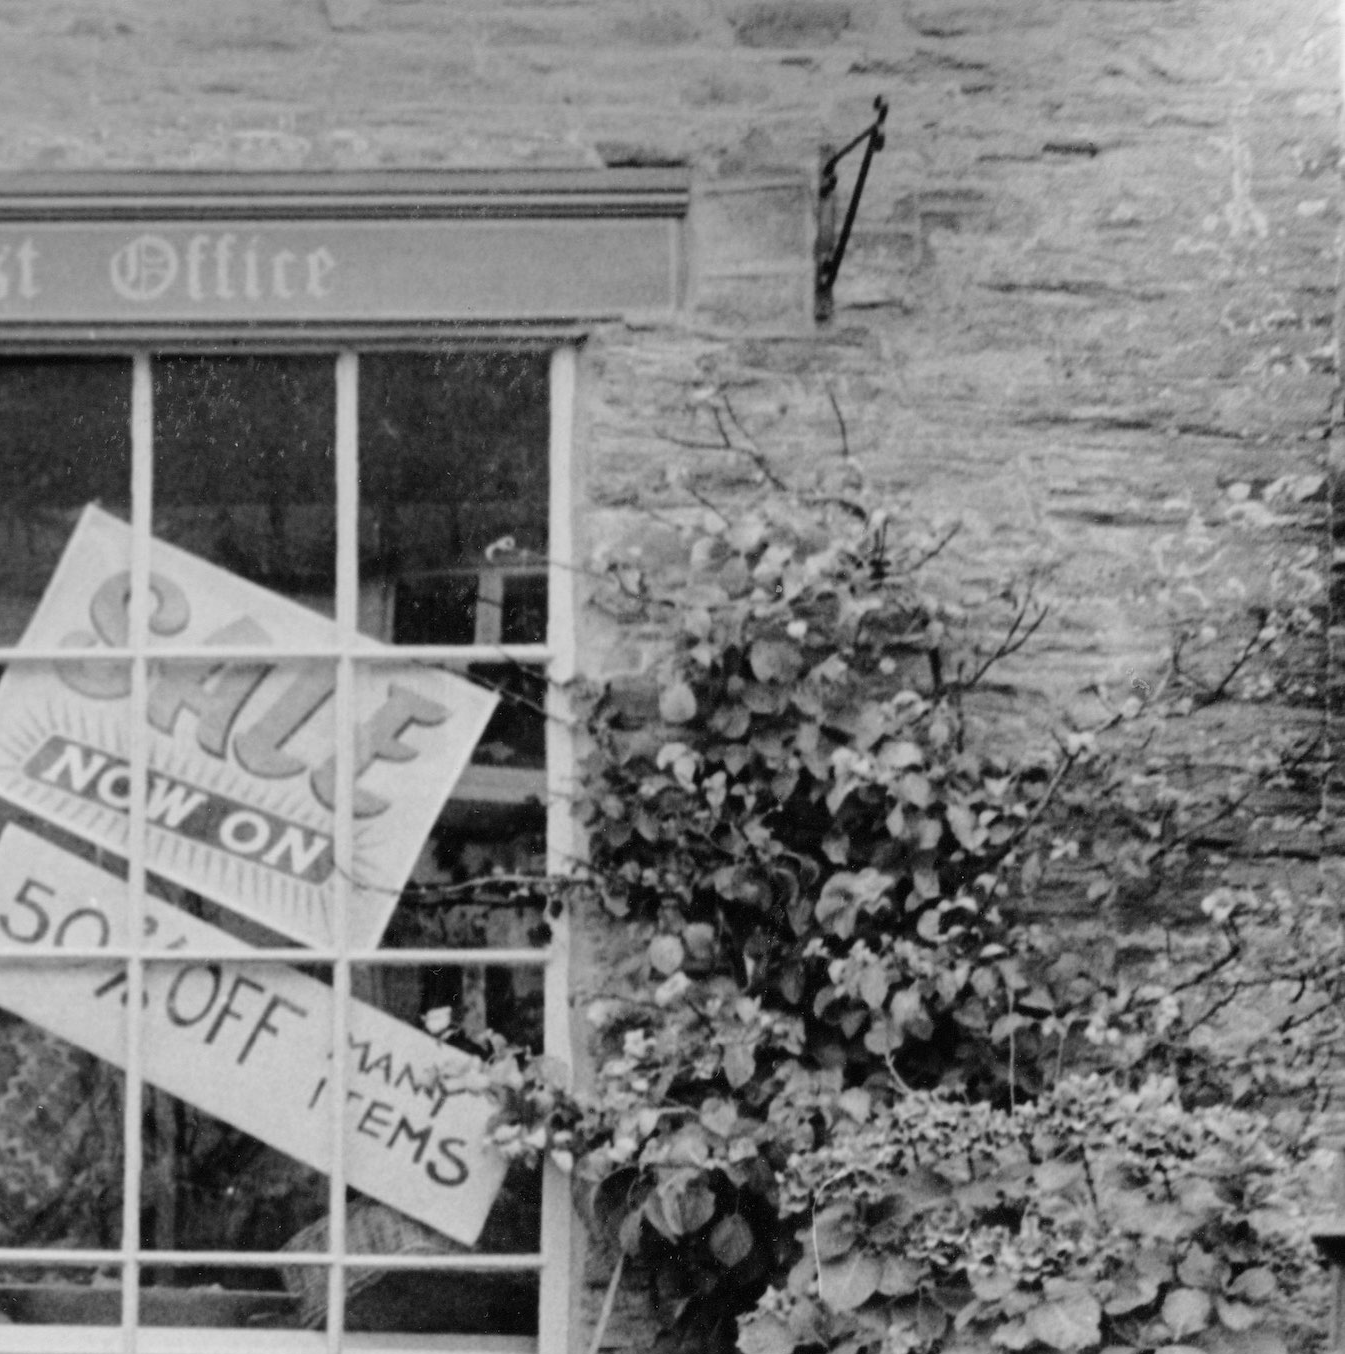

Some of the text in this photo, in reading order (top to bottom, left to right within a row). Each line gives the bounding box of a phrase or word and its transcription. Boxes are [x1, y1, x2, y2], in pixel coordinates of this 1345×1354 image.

[109, 232, 337, 301] Office
[52, 568, 452, 820] SALE
[40, 743, 331, 876] NOW ON
[164, 958, 308, 1067] OFF
